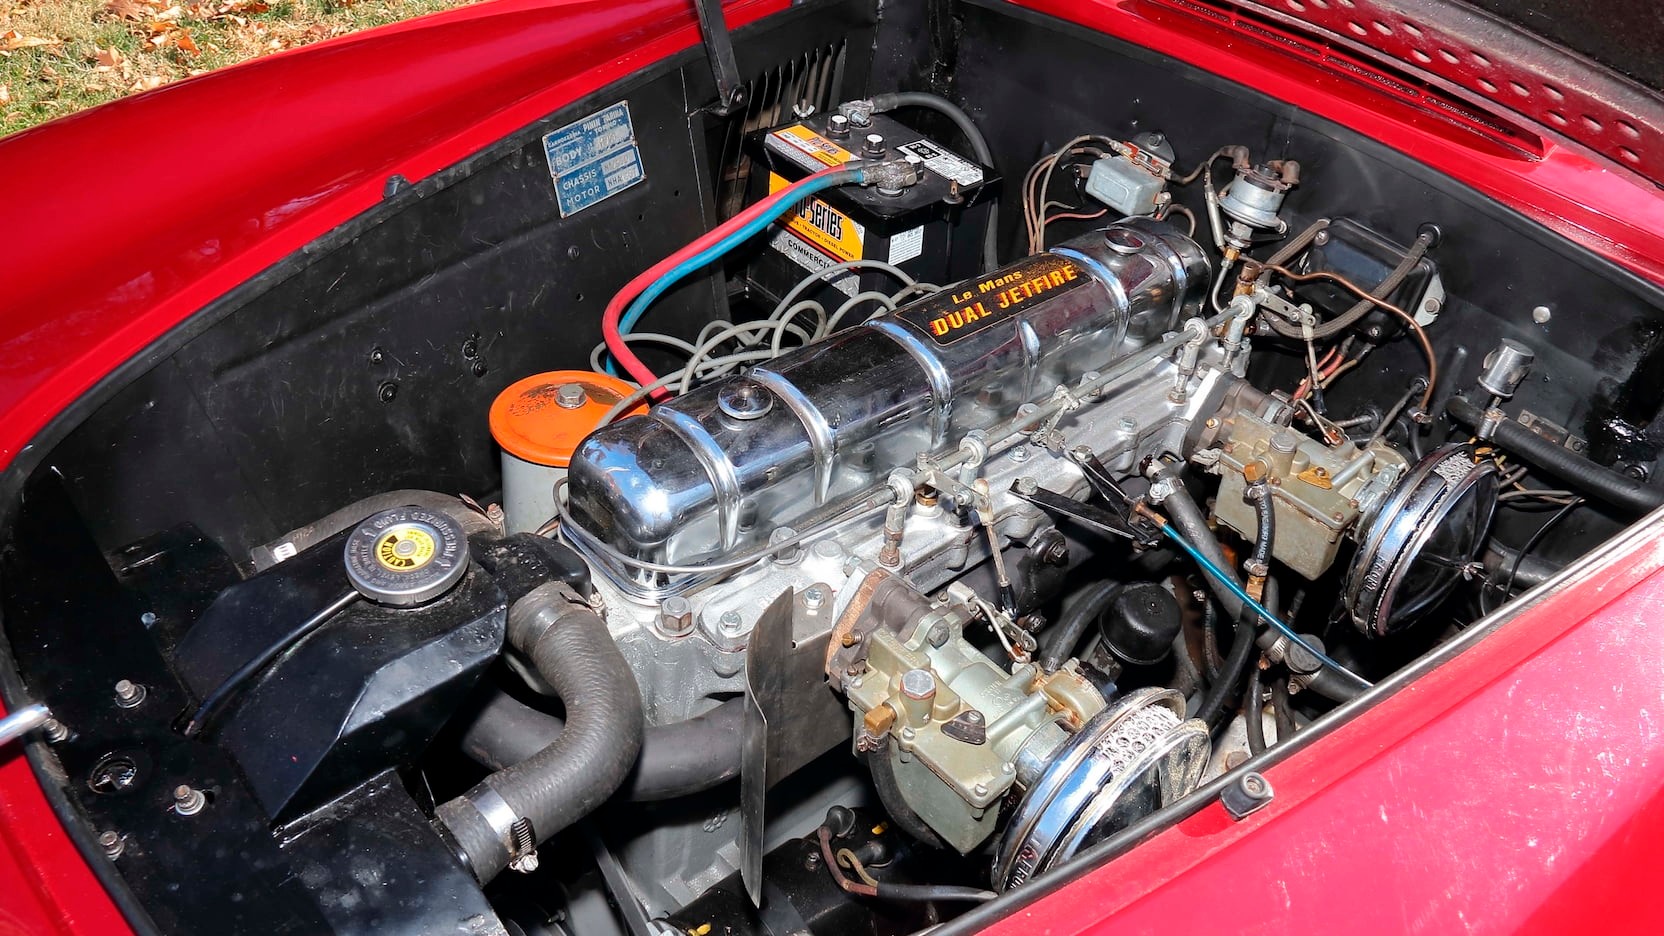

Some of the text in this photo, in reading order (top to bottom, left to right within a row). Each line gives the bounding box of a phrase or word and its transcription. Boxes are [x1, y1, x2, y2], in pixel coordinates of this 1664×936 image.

[555, 147, 582, 167] BODY
[563, 169, 598, 190] CHASSIS
[566, 185, 600, 206] MOTOR
[951, 270, 1023, 305] Le Mans
[929, 265, 1079, 337] DUAL JETFIRE
[411, 511, 457, 557] PRESSURIZED
[382, 541, 407, 567] CAUTION
